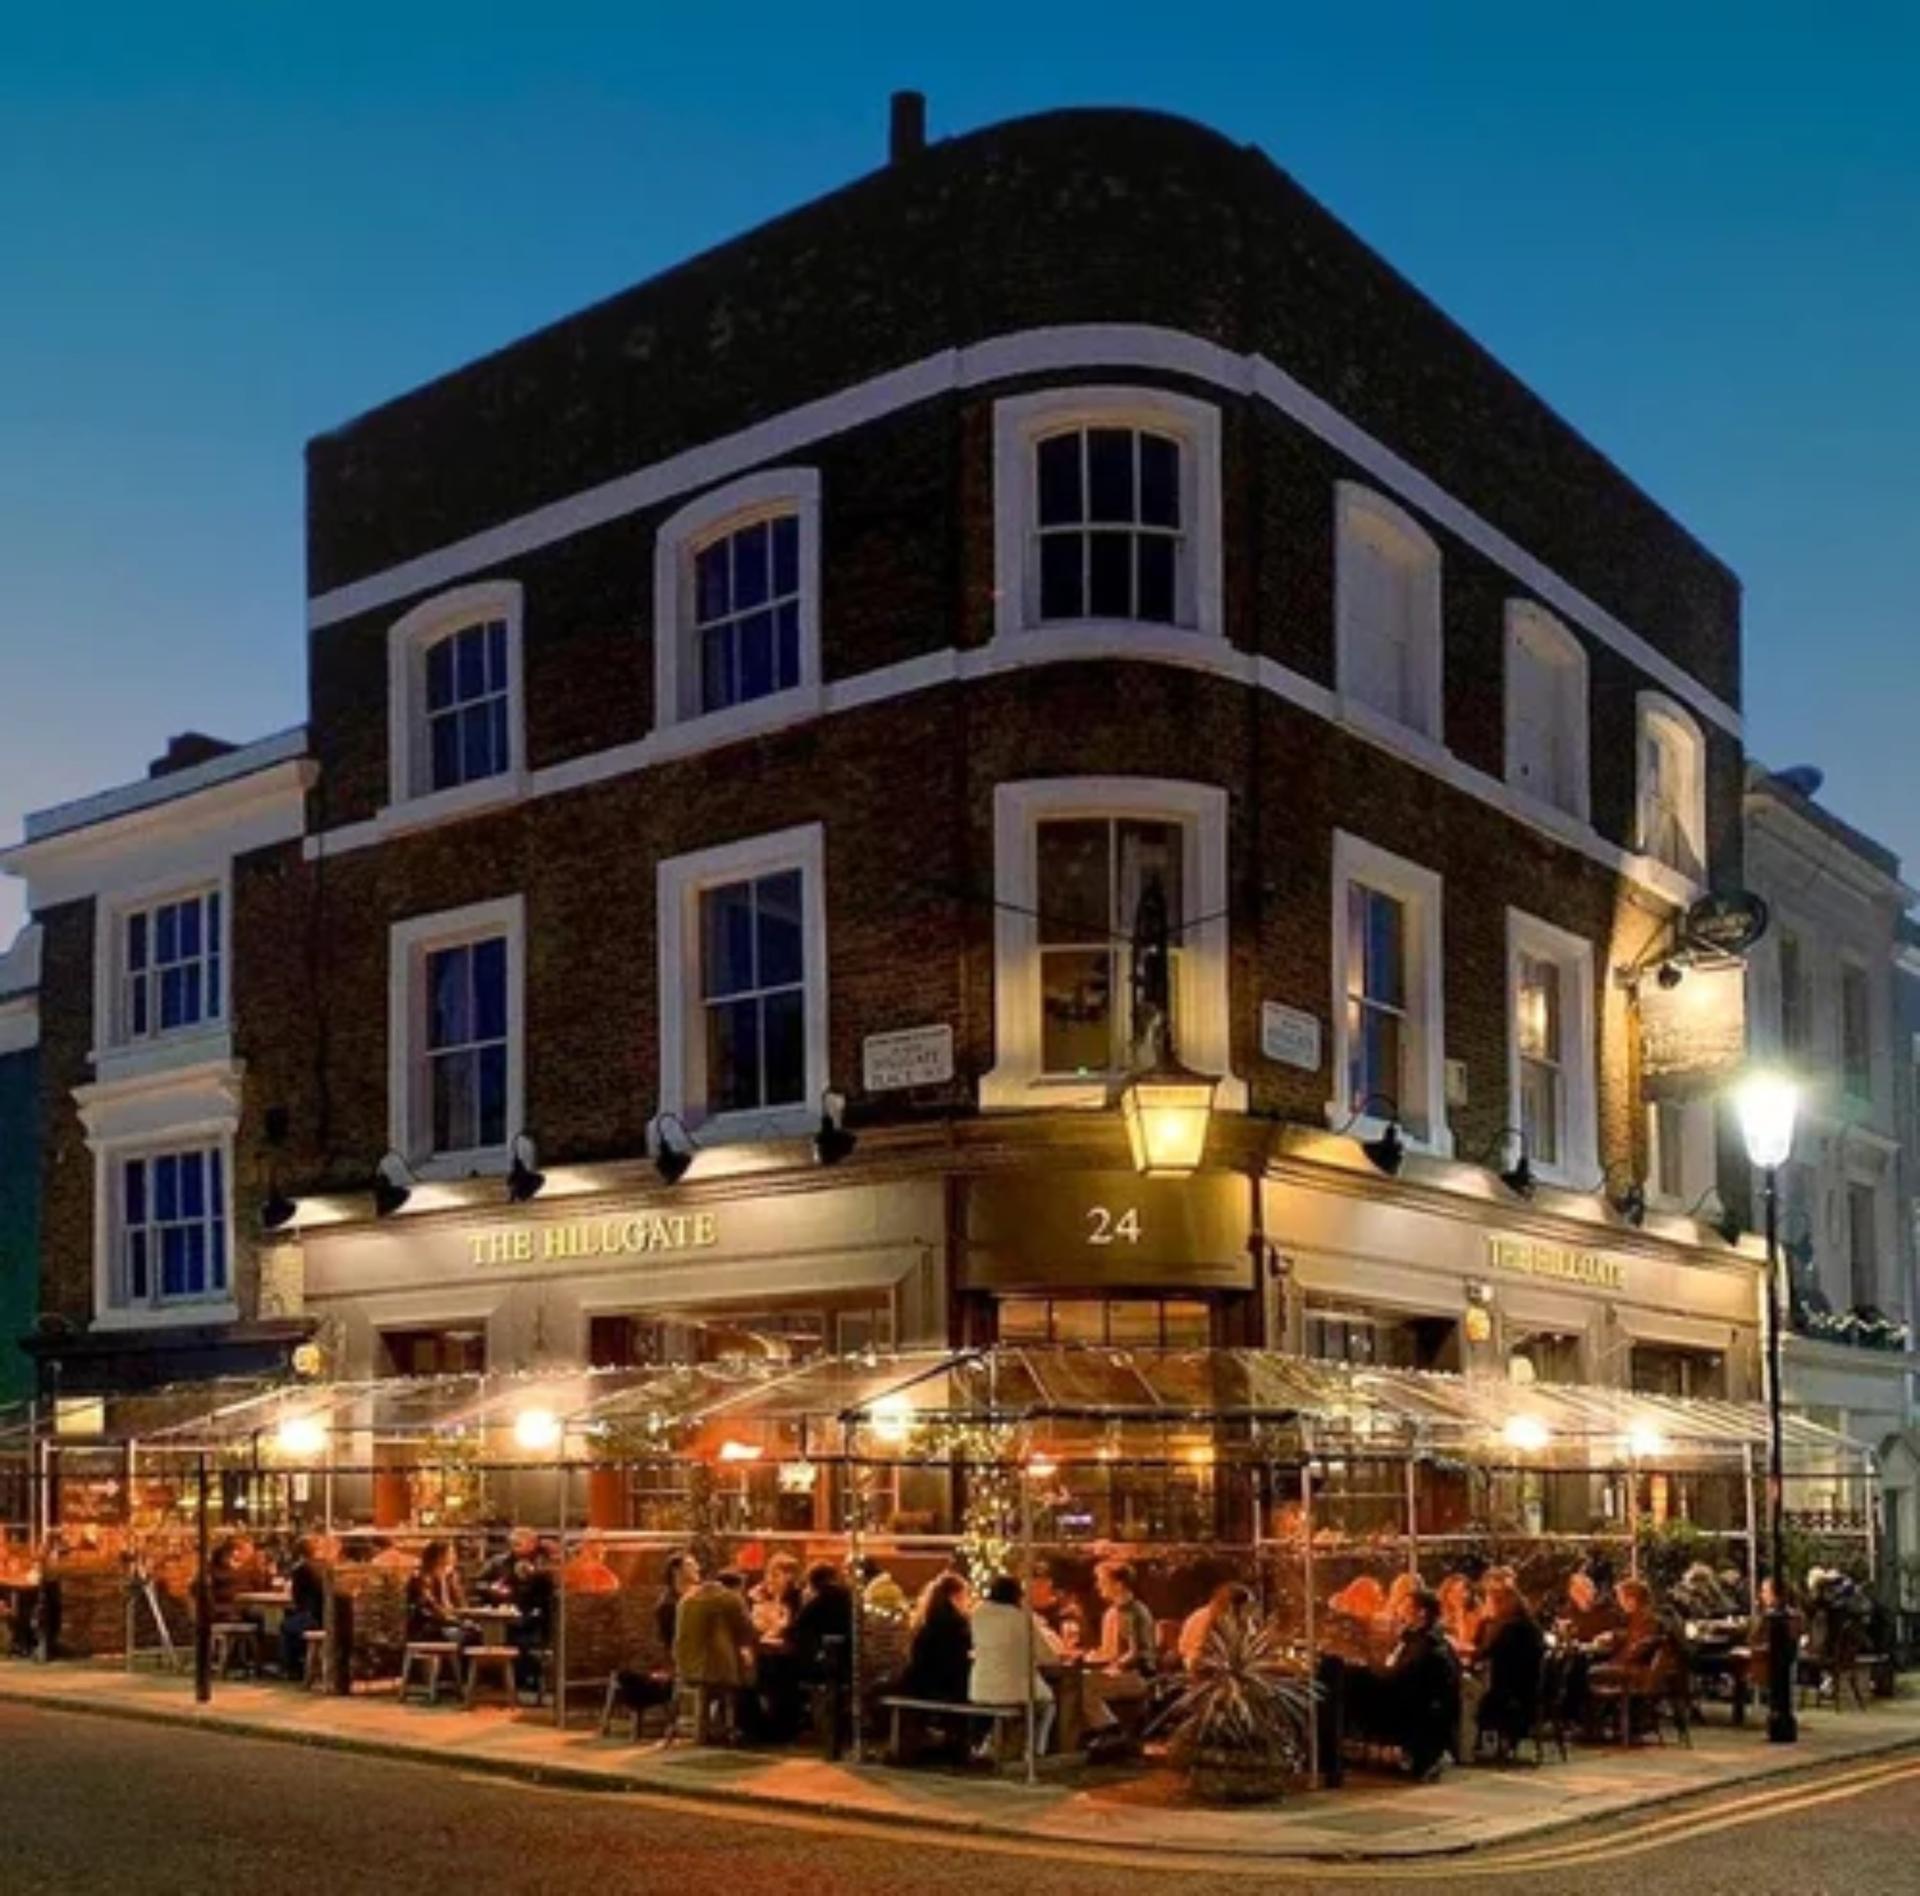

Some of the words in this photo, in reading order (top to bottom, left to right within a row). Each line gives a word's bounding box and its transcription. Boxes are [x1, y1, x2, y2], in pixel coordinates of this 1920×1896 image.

[468, 1231, 534, 1264] THE
[544, 1213, 716, 1257] HILLGATE
[1086, 1207, 1141, 1245] 24
